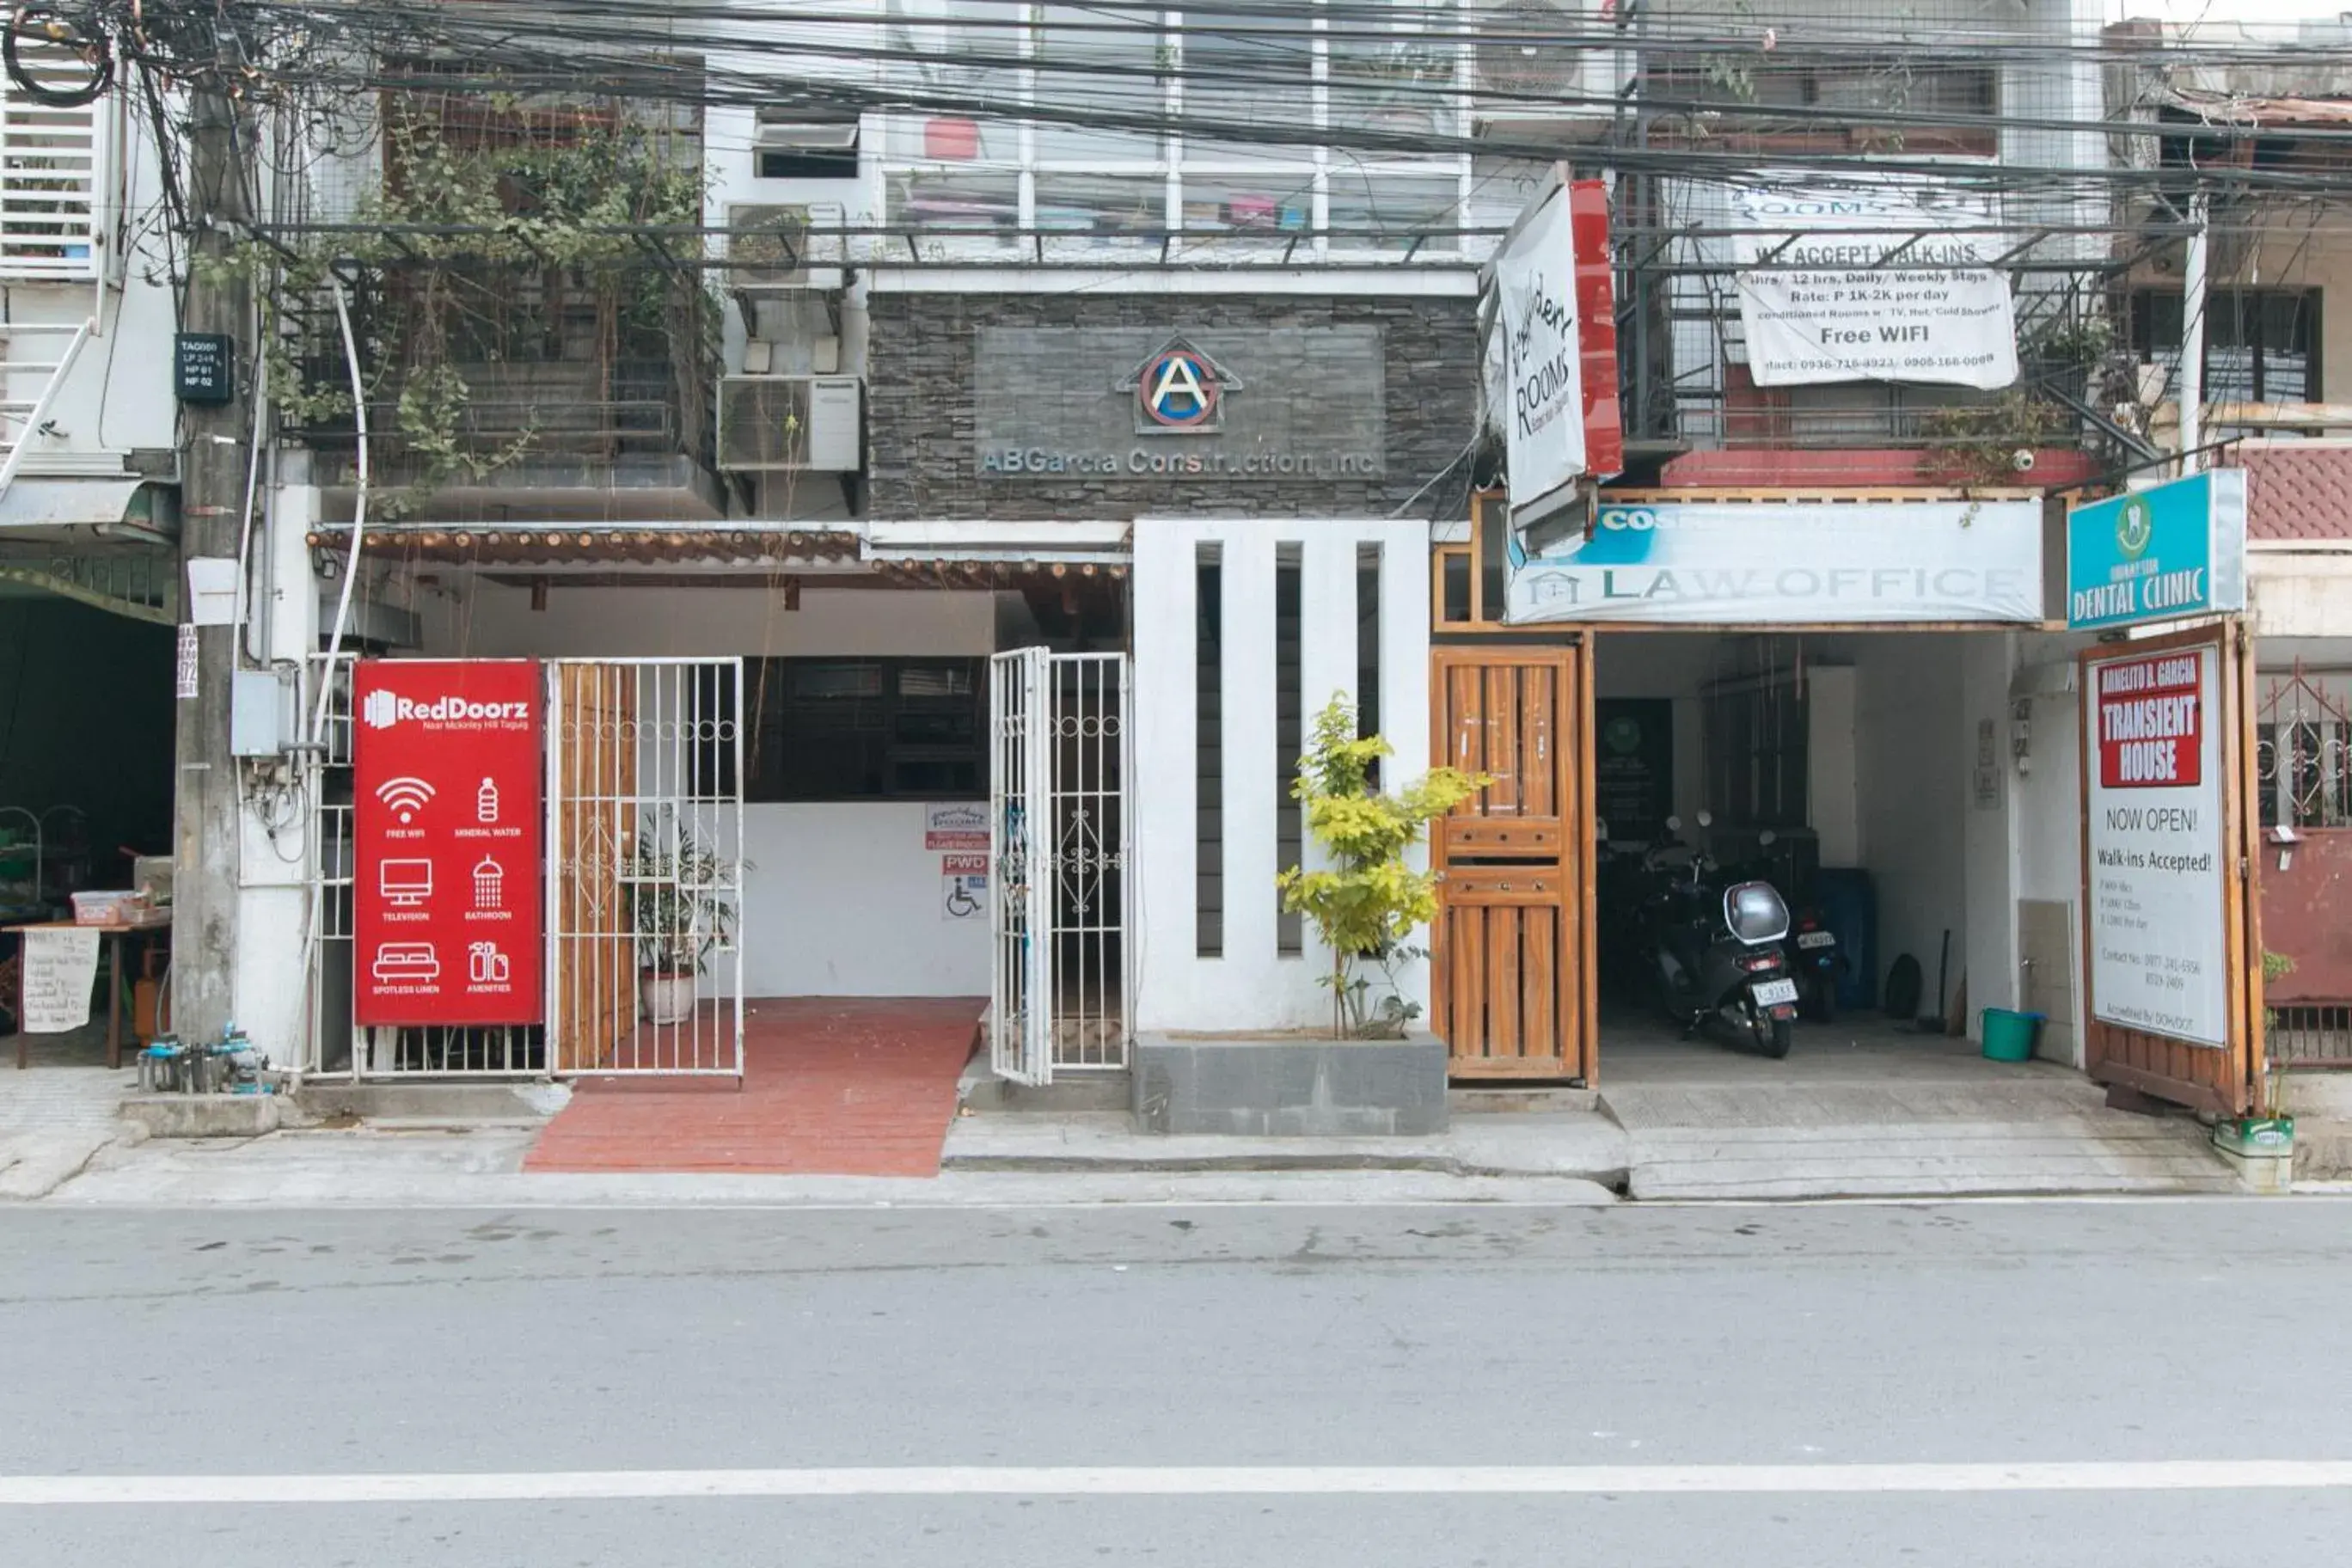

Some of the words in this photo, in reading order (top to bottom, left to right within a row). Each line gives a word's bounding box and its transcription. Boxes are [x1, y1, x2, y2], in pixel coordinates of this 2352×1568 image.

[1793, 244, 1872, 265] ACCEPT
[1877, 242, 1976, 264] WALK-INS
[1895, 271, 1946, 285] Weekly
[1923, 288, 1950, 302] day
[1820, 327, 1871, 345] Free
[1878, 325, 1930, 343] WIFI
[1603, 568, 1757, 599] LAW
[1774, 567, 2024, 598] OFFICE
[2073, 580, 2136, 622] DENTAL
[2143, 567, 2204, 609] CLINIC
[397, 695, 529, 720] RedDoorz
[2102, 694, 2196, 741] TRANSIENT
[2120, 739, 2177, 781] HOUSE
[2106, 807, 2143, 831] NOW
[2147, 807, 2198, 832] OPEN!
[946, 856, 985, 868] PWD
[2098, 847, 2145, 868] Walk-ins
[2147, 849, 2212, 874] Accepted!
[465, 911, 512, 921] BATHROOM
